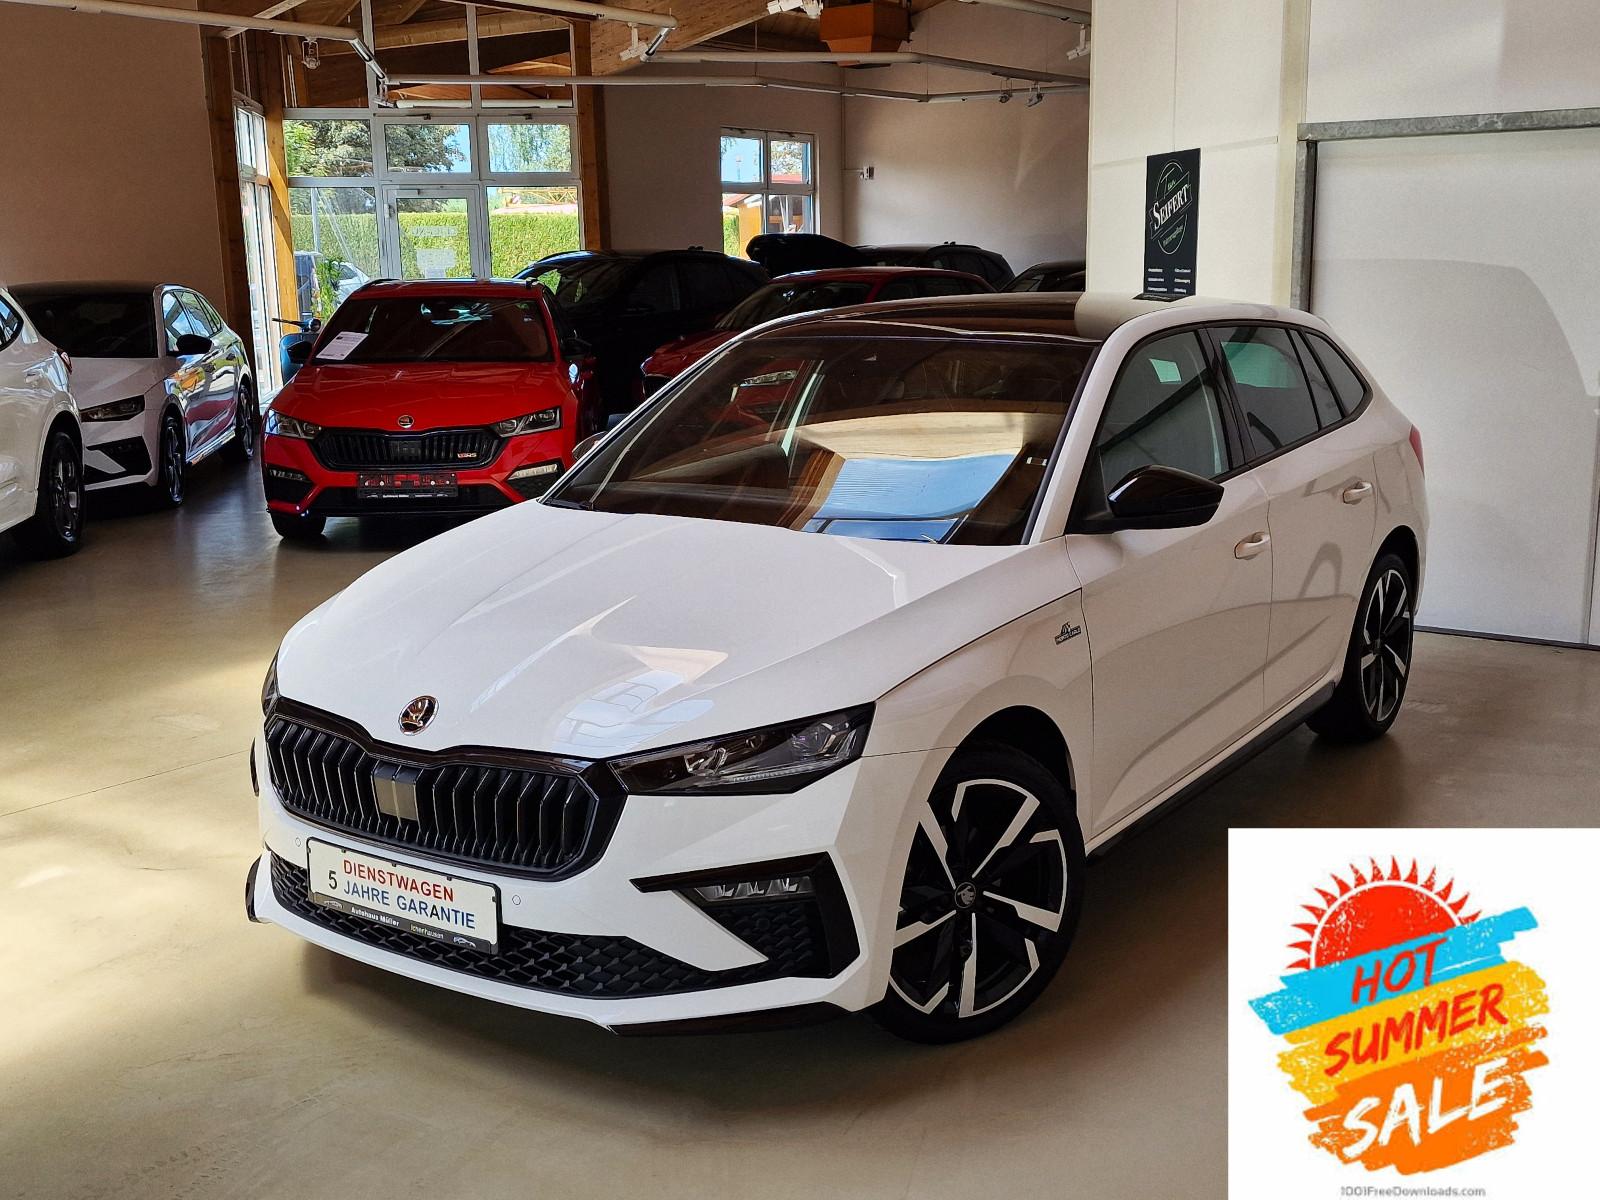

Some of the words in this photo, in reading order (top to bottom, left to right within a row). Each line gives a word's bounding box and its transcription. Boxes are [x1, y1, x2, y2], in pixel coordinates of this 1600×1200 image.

[1152, 183, 1190, 230] SEIFERT
[328, 869, 338, 890] 5
[343, 880, 391, 906] JAHRE
[396, 895, 476, 930] GARANTIE
[343, 858, 454, 903] DIENSTWAGEN
[351, 906, 379, 921] Autohaus
[379, 914, 400, 927] Müller
